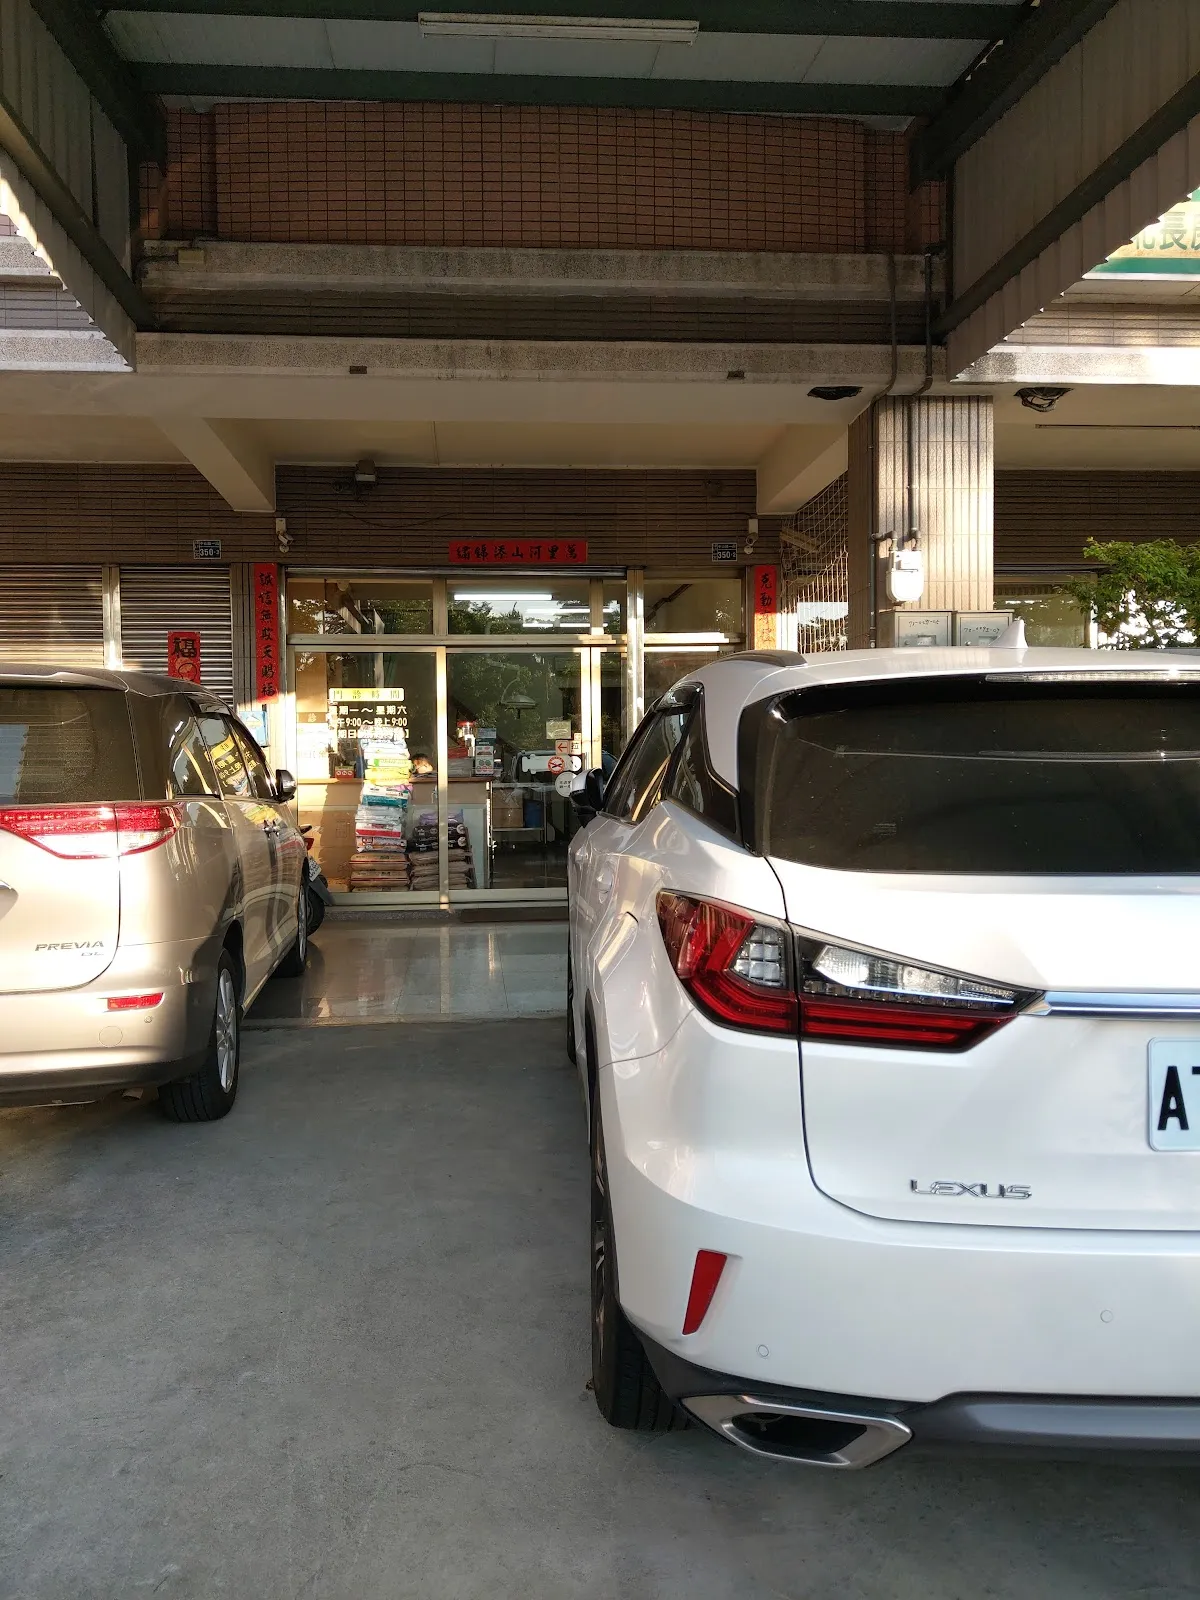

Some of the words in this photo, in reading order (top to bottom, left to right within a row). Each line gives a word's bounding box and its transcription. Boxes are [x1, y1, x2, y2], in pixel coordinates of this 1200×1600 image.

[171, 636, 198, 659] 福
[35, 941, 104, 951] PREVIA
[1158, 1066, 1200, 1131] A
[910, 1180, 1032, 1200] LEXUS
